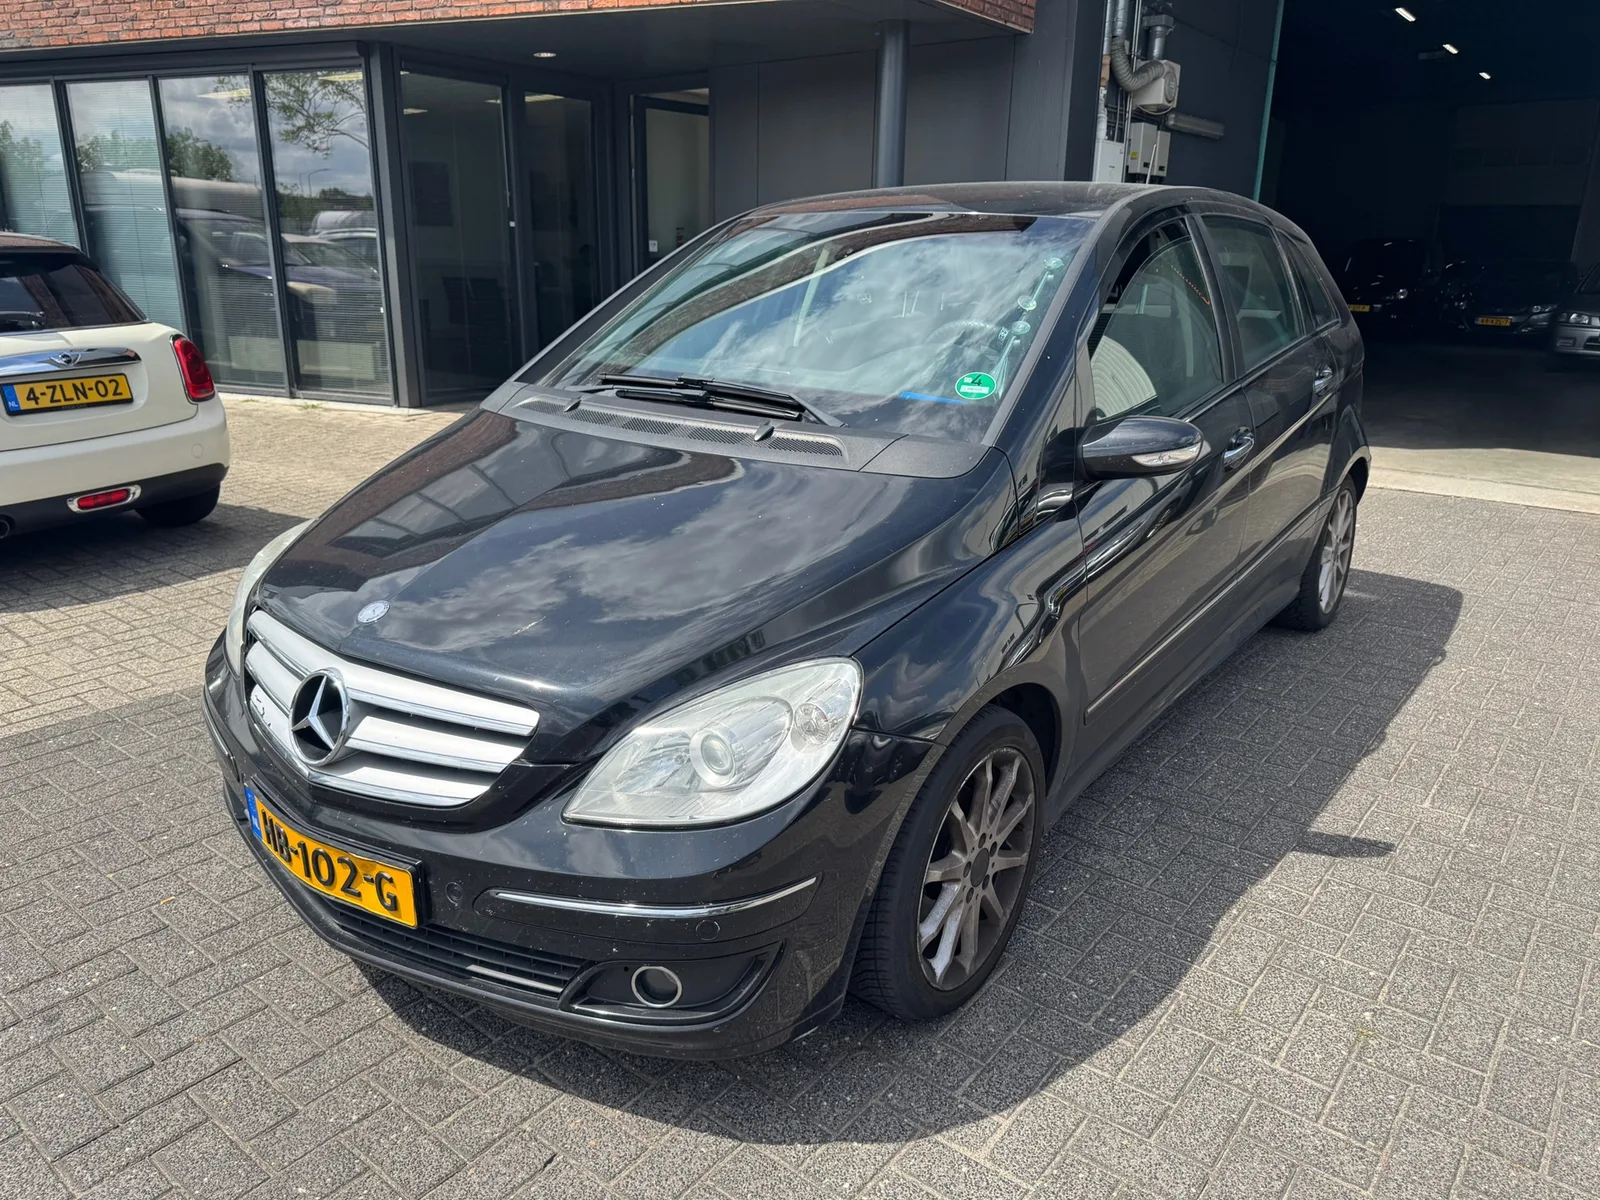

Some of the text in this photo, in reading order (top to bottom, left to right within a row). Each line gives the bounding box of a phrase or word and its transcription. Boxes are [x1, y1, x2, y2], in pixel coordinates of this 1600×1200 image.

[26, 379, 123, 405] 4-ZLN-02
[971, 374, 982, 386] 4
[261, 809, 398, 912] HB-102-G
